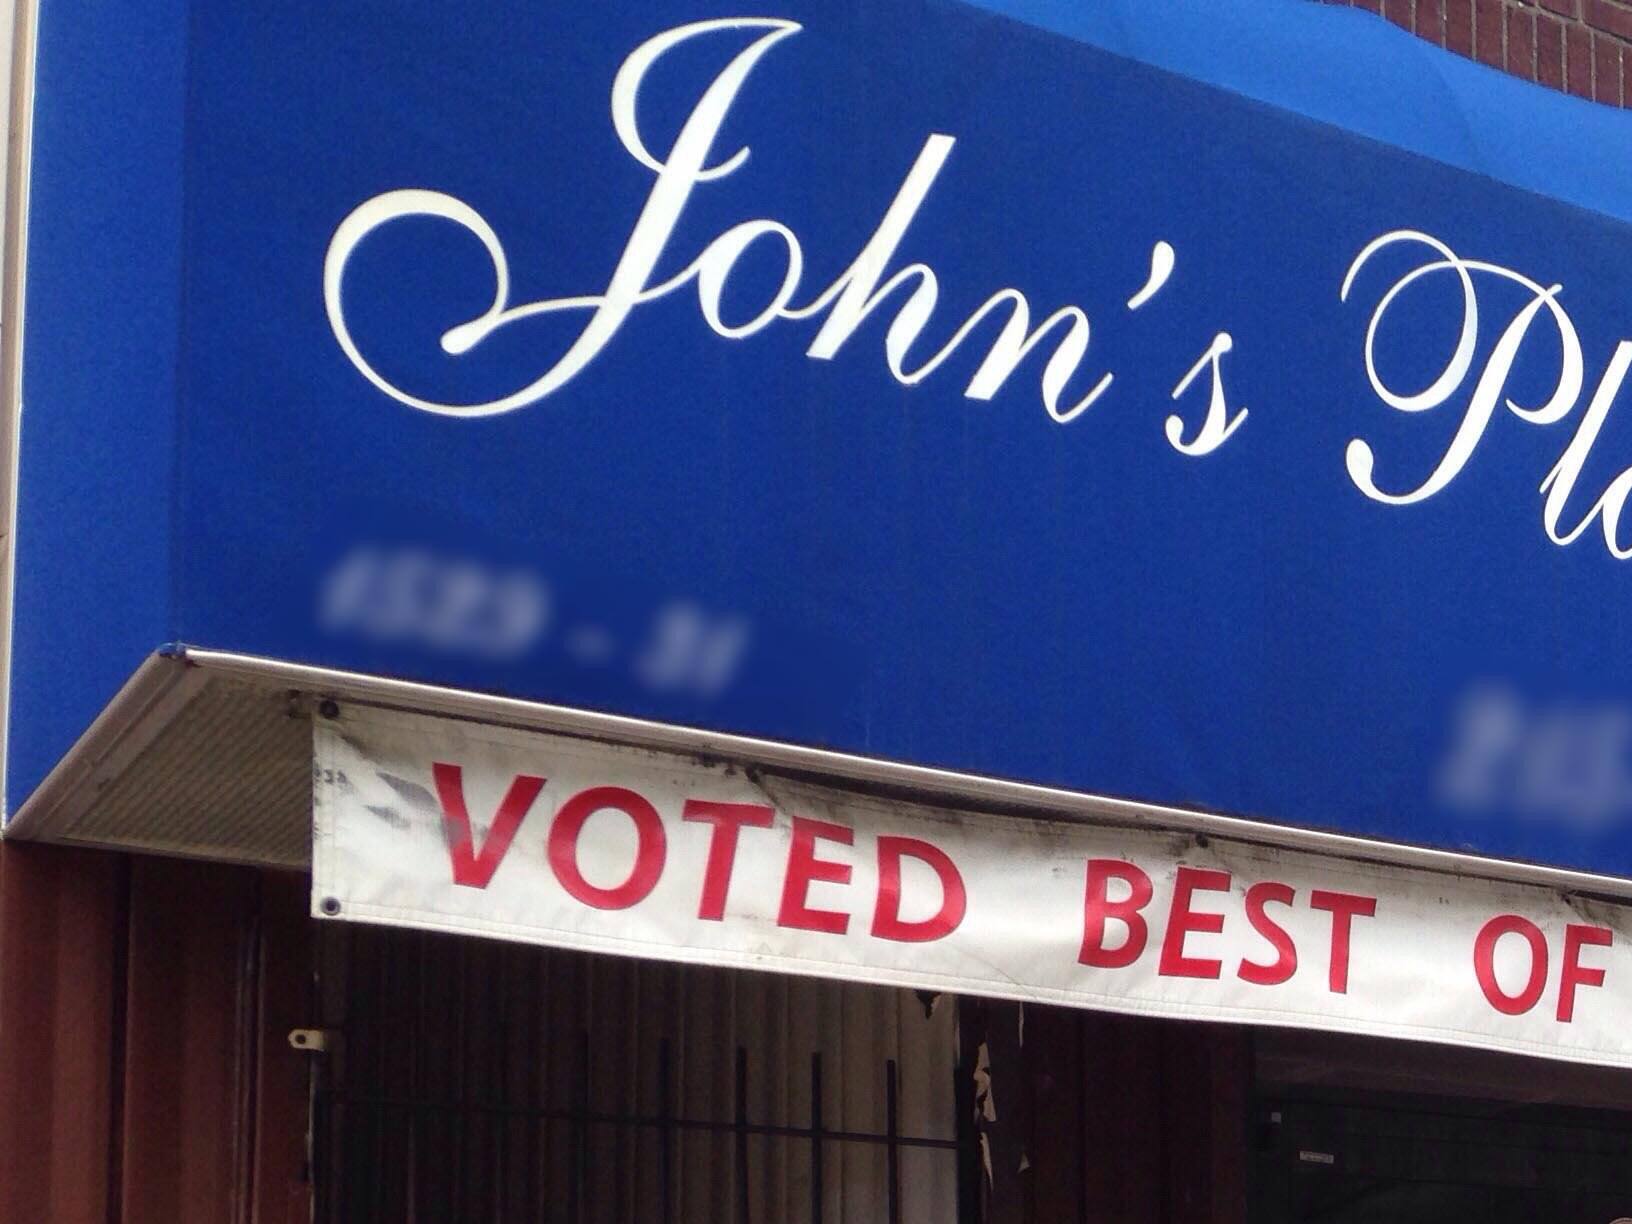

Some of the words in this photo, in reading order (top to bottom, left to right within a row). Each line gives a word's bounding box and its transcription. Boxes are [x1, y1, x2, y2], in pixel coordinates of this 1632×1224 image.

[325, 18, 1248, 455] John's
[437, 762, 965, 944] VOTED
[1079, 859, 1376, 993] BEST
[1473, 915, 1613, 1023] OF
